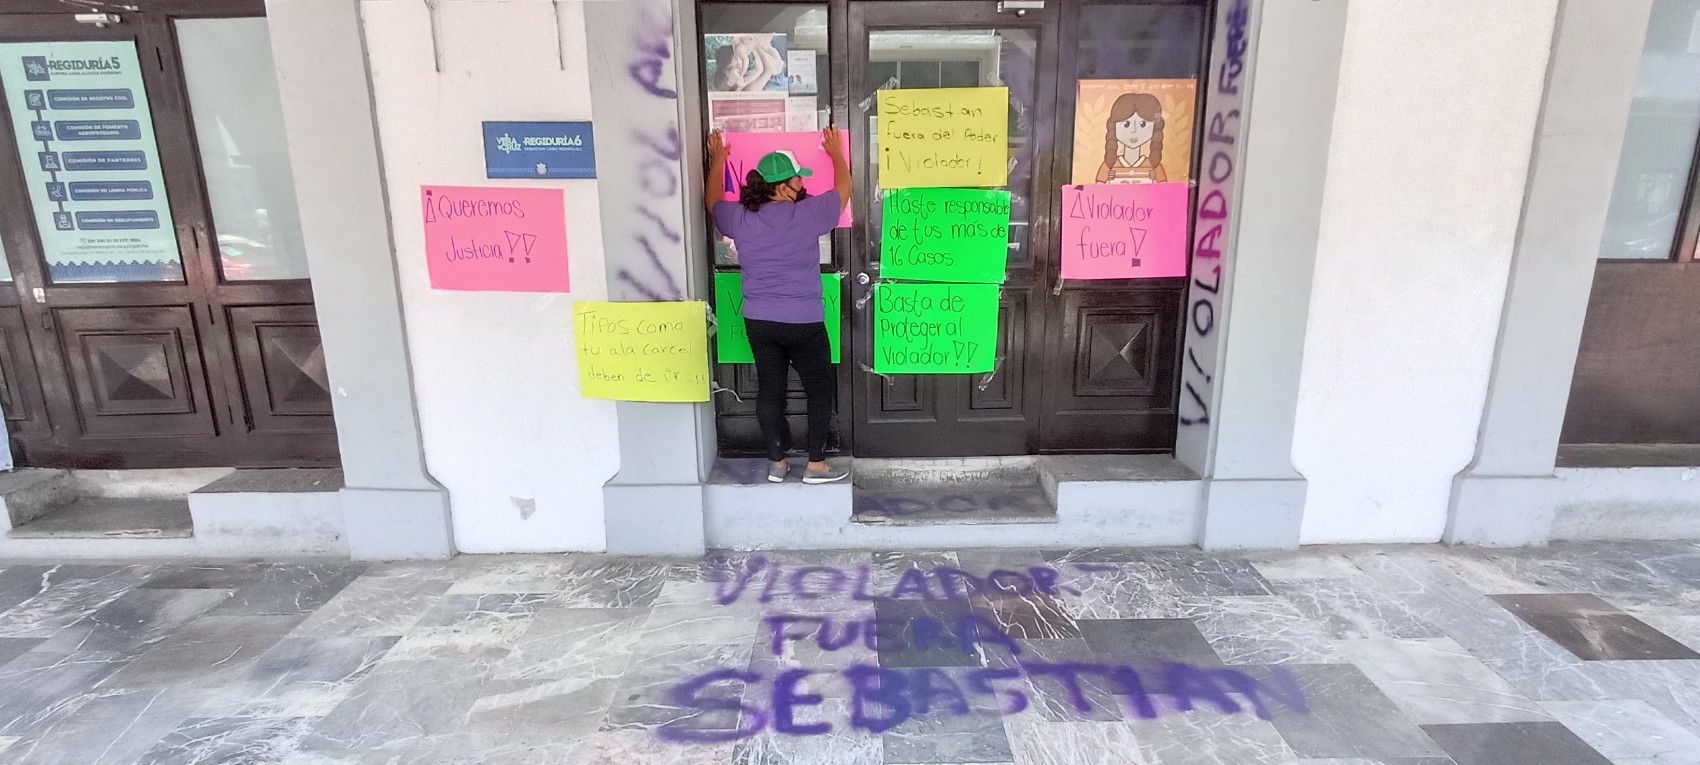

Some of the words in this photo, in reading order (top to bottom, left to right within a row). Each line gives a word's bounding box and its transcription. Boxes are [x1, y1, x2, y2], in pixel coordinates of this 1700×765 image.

[887, 120, 924, 139] fuera
[932, 128, 955, 140] del
[890, 218, 908, 240] de
[913, 217, 942, 245] tus
[951, 220, 988, 239] más
[990, 223, 1006, 238] de
[889, 245, 903, 266] 16
[1180, 109, 1240, 427] VIOLADOR
[879, 286, 933, 317] Basta
[940, 286, 965, 313] de
[946, 317, 962, 336] al
[582, 342, 600, 355] tu
[588, 364, 624, 382] deben
[635, 367, 656, 382] de
[709, 555, 1081, 606] VIOLADOR
[765, 615, 1022, 656] FUERA
[656, 661, 1309, 743] SEBASTIAN
